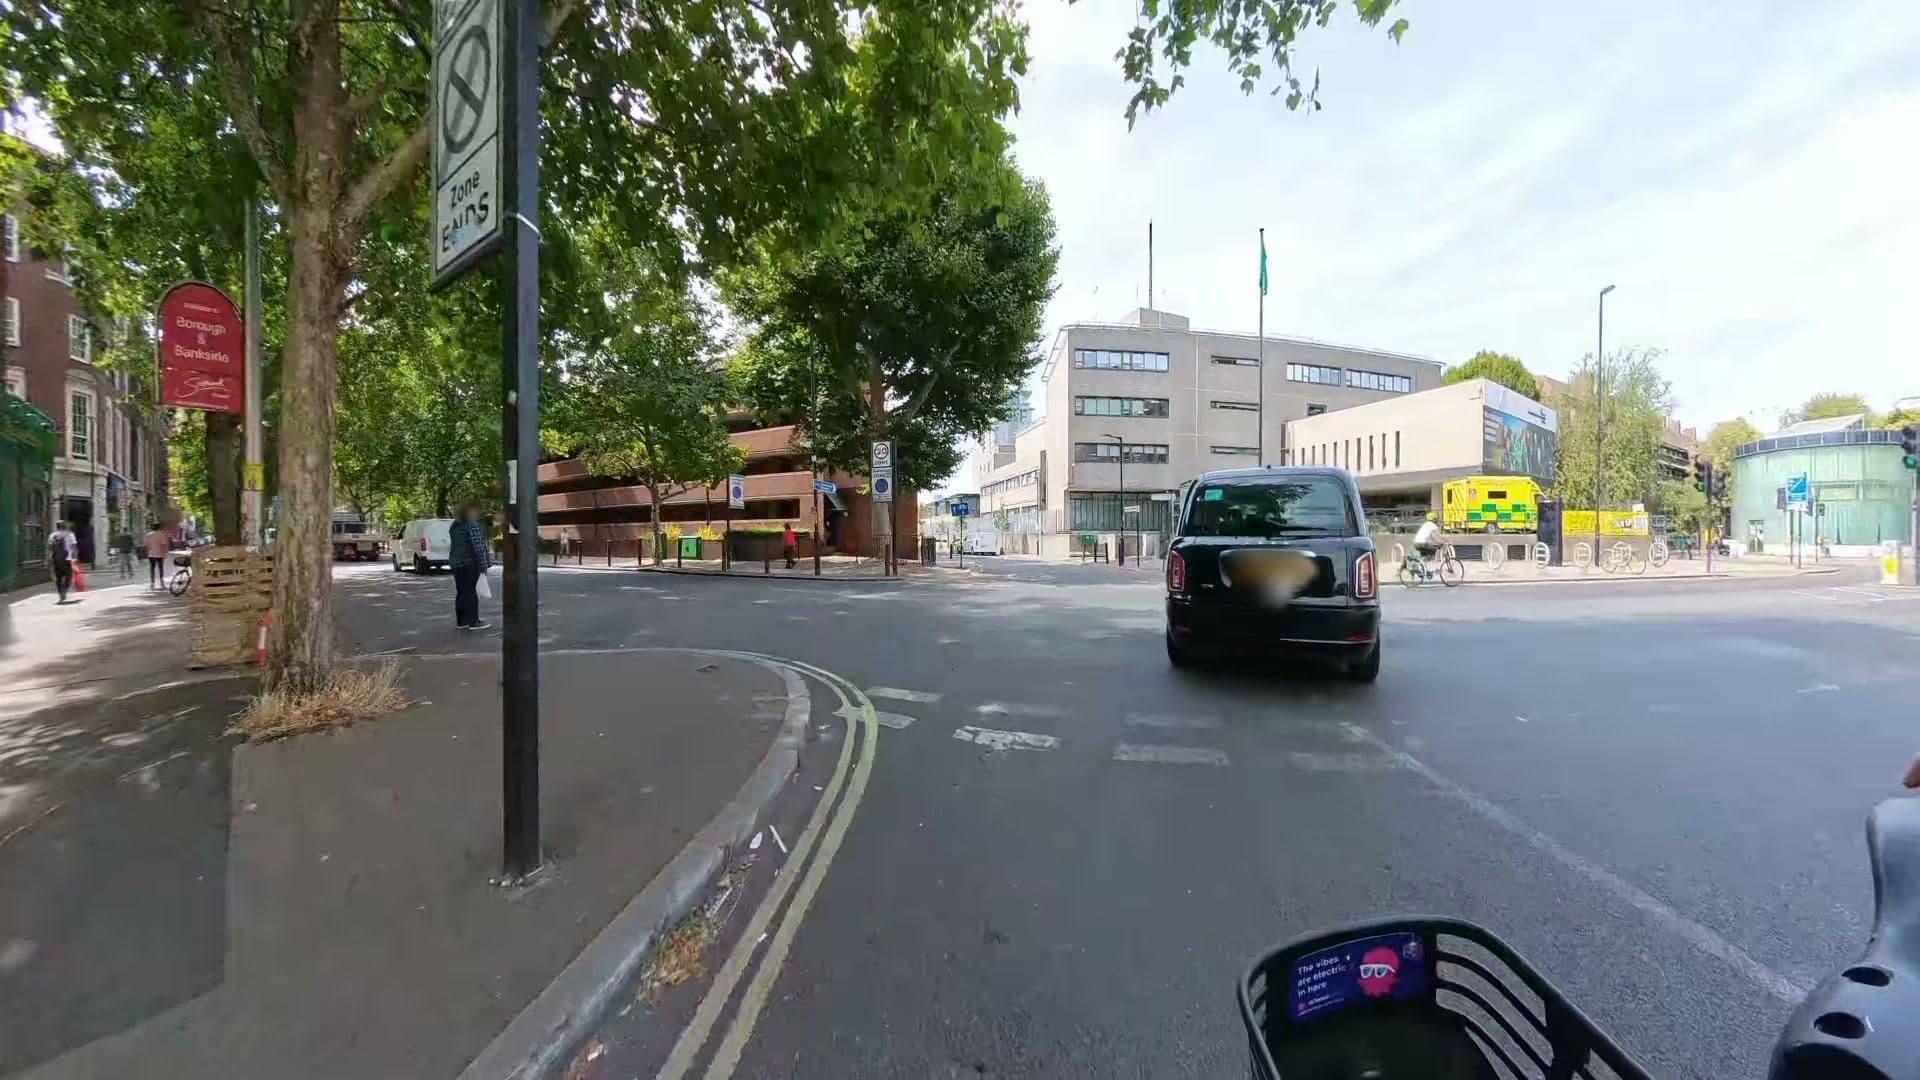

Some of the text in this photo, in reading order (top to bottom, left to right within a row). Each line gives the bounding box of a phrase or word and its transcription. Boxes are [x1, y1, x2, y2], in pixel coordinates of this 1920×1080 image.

[450, 171, 480, 208] Zone
[442, 192, 489, 252] ENDS
[176, 317, 226, 336] Borough
[197, 334, 205, 345] &
[175, 345, 229, 363] Bankside
[1298, 956, 1339, 976] The vibes
[1298, 964, 1346, 987] are electric
[1298, 982, 1327, 999] in here
